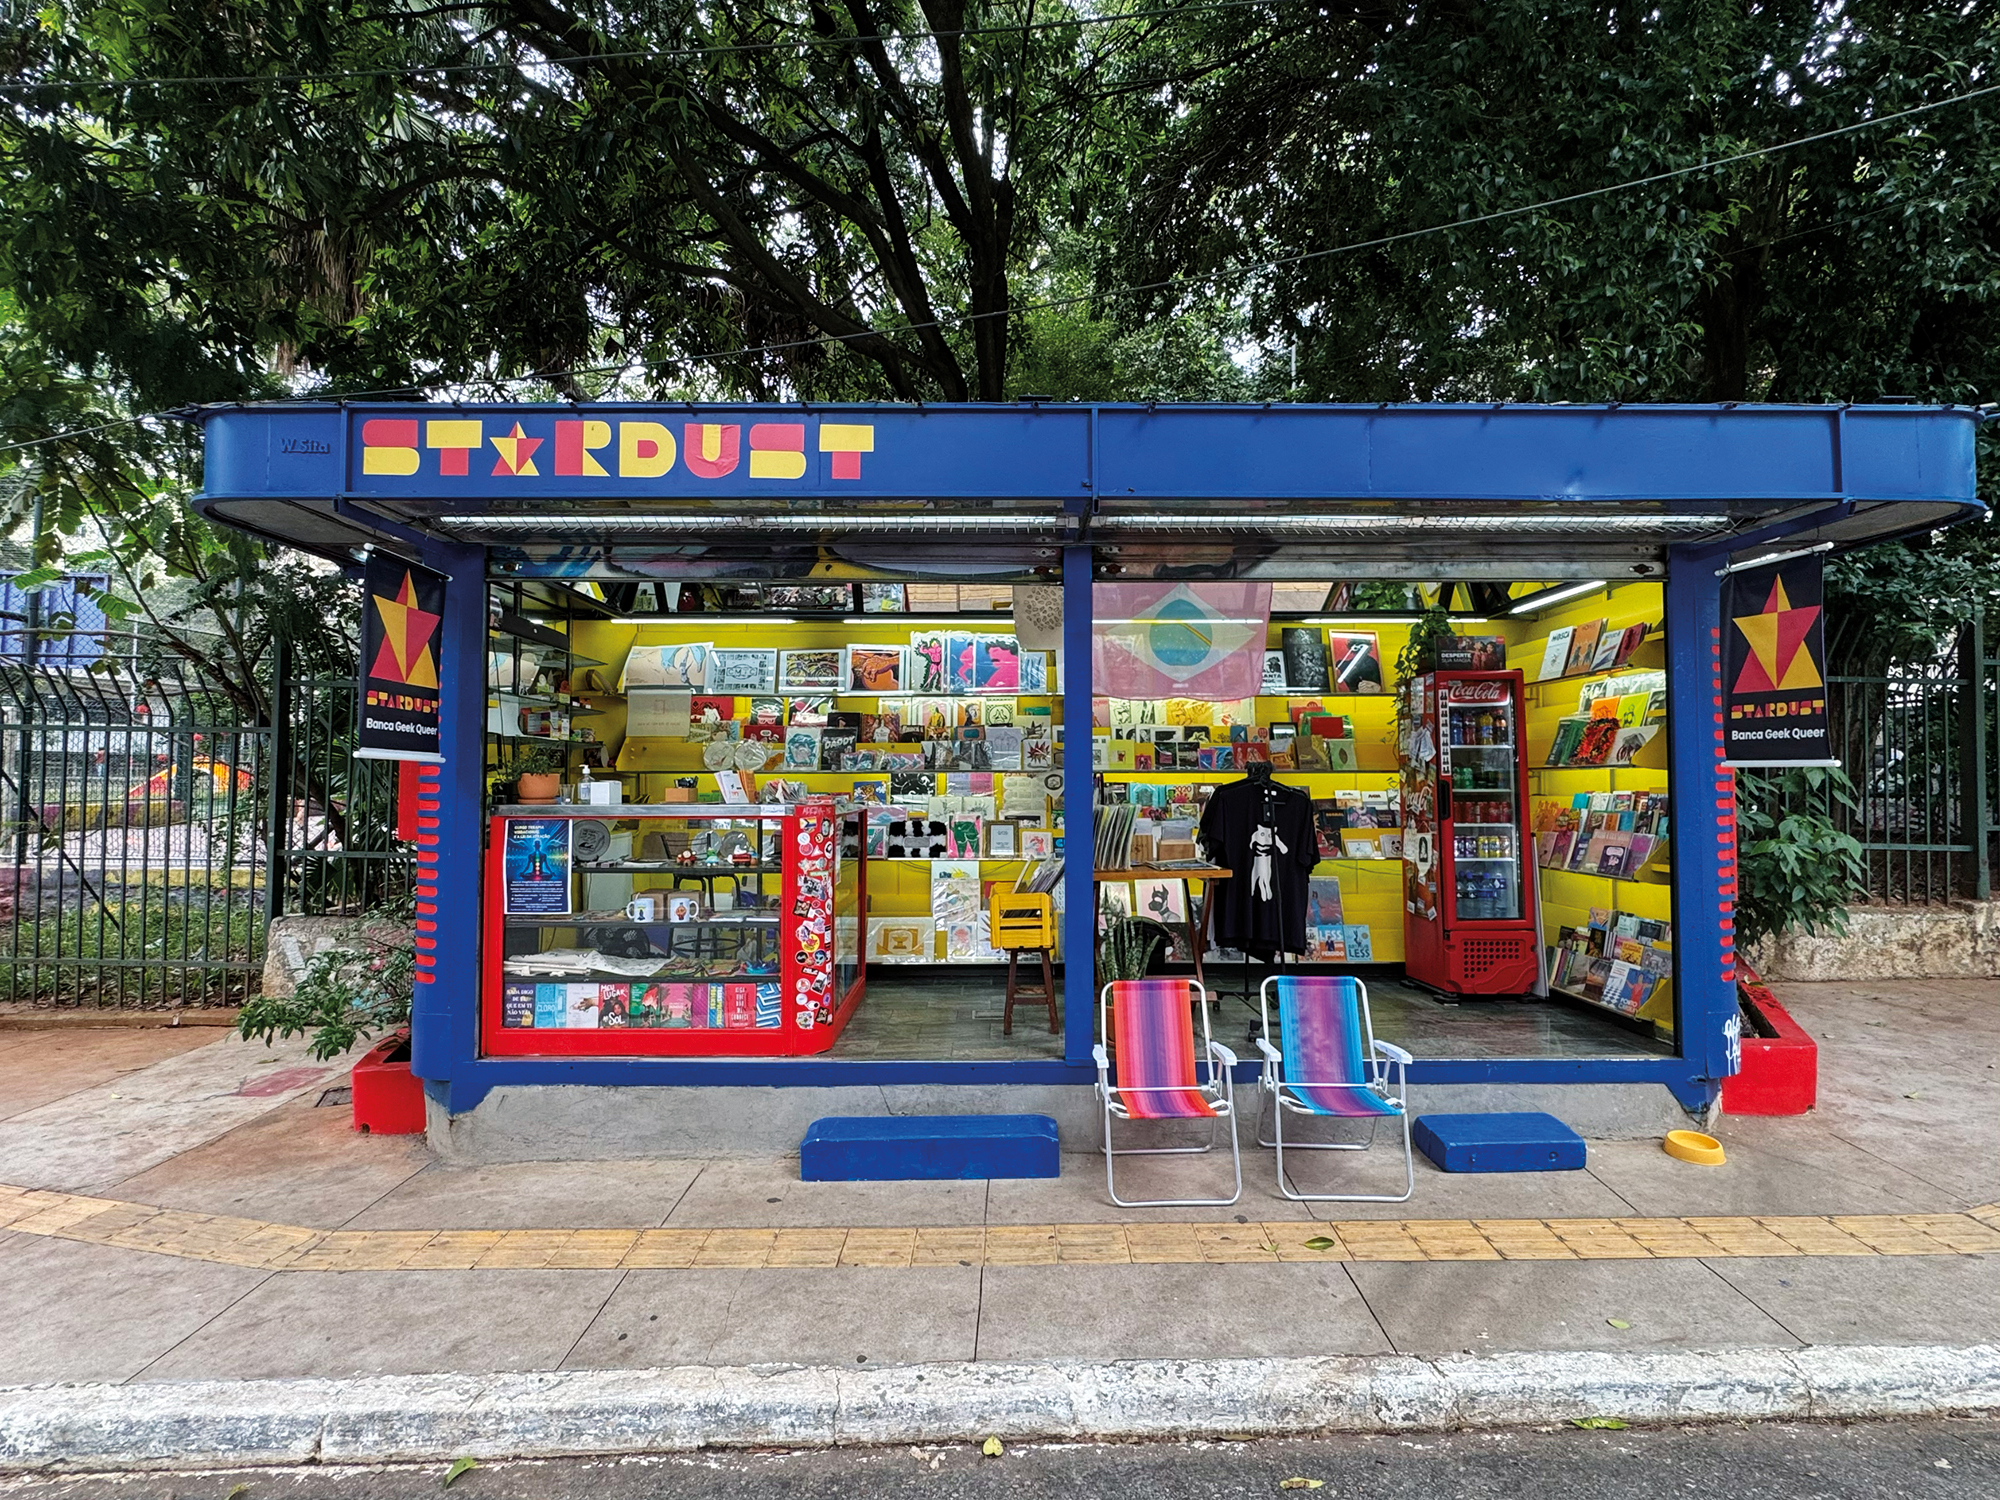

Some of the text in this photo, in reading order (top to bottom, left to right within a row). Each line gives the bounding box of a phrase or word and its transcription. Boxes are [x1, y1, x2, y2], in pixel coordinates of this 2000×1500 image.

[362, 418, 875, 480] STARDUST
[366, 690, 439, 714] STARDUST
[1730, 699, 1825, 719] STARDUST
[366, 717, 438, 736] Banca Geek Queer
[1731, 727, 1825, 741] Banca Geek Queer
[824, 735, 856, 750] DADDY
[1319, 930, 1343, 941] LESS
[1348, 948, 1370, 958] LESS
[600, 984, 615, 992] MEU
[603, 989, 628, 1001] LUGAR
[536, 1004, 556, 1012] CLORO
[608, 1011, 626, 1026] SOL
